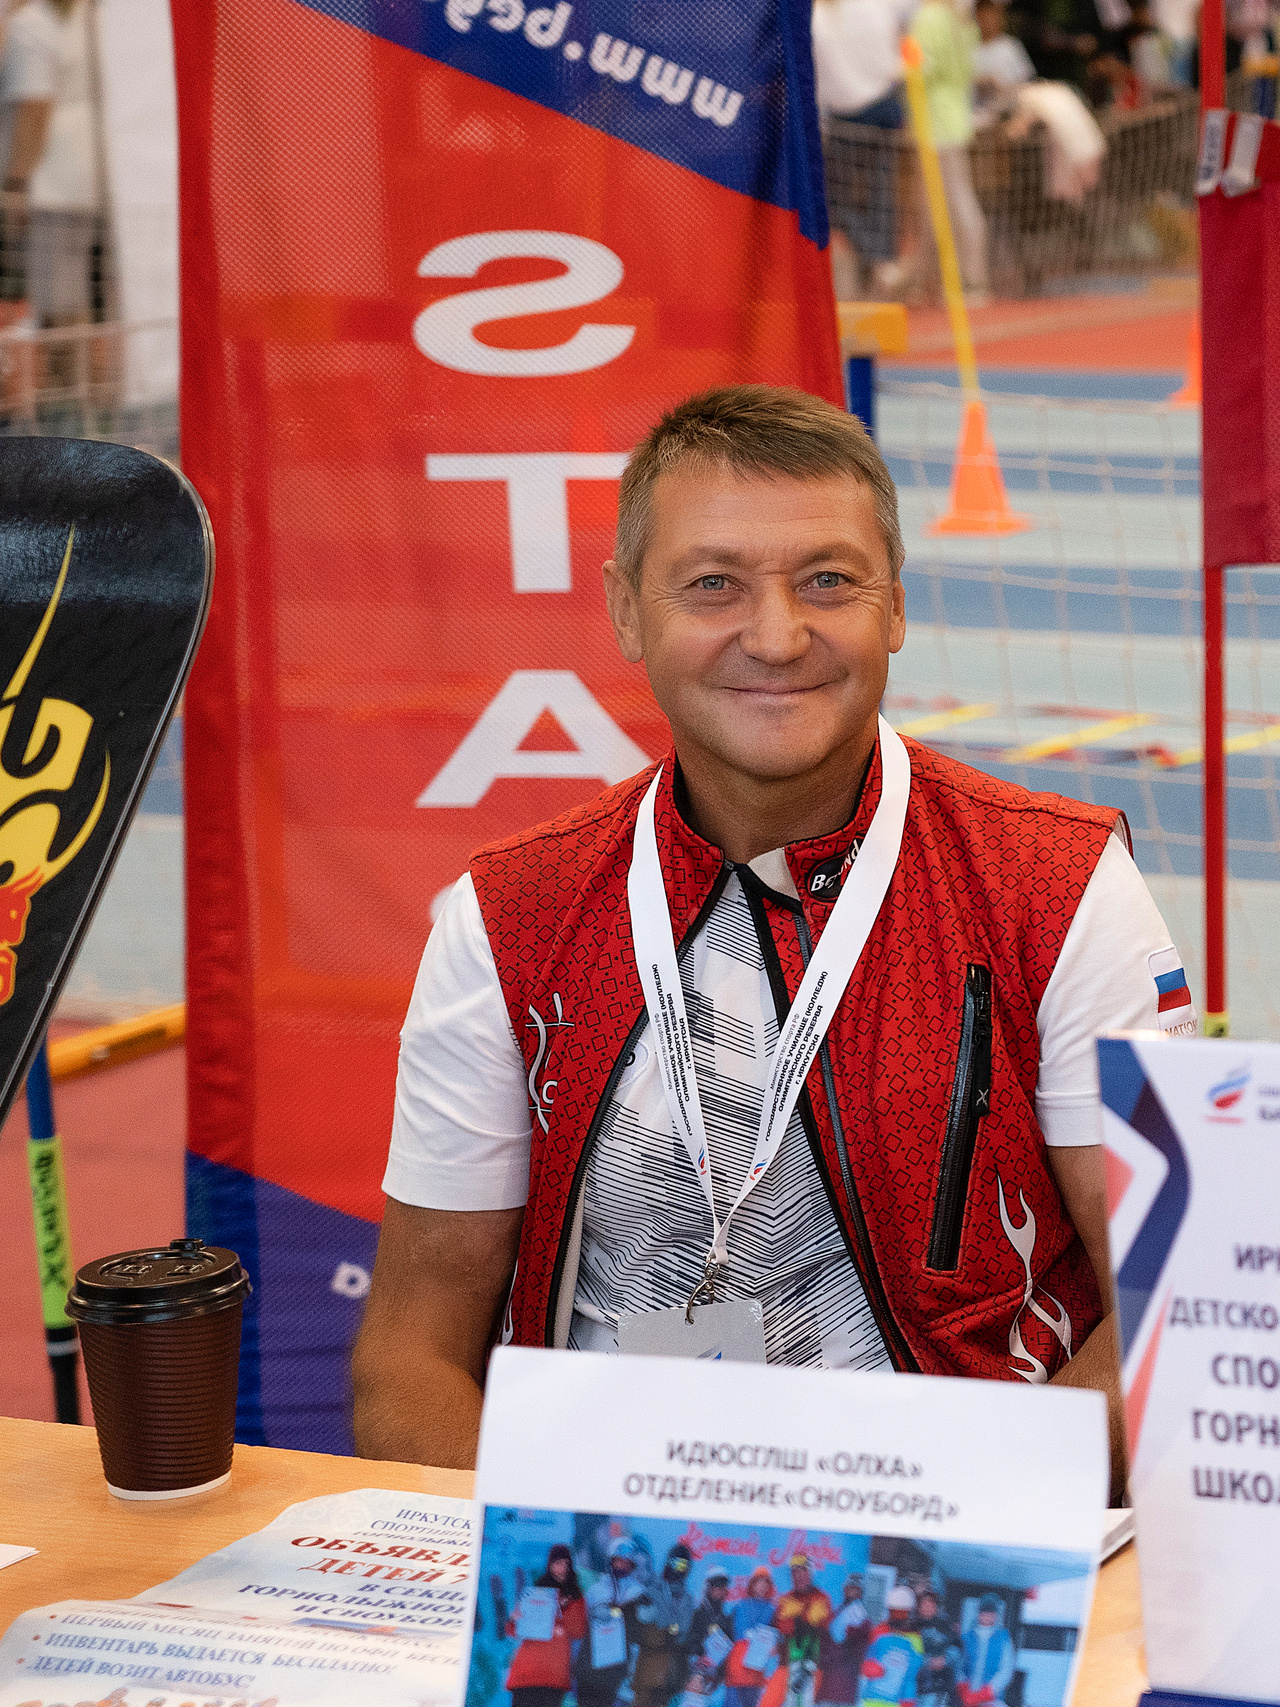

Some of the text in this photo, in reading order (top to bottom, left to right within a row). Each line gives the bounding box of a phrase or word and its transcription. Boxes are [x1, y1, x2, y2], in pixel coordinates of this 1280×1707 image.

[651, 964, 693, 1136] ГОСУДАРСТВЕННОЕ УЧИЛИЩЕ (КОЛЛЕДЖ)
[666, 993, 692, 1102] ОЛИМПИЙСКОГО РЕЗЕРВА
[678, 1018, 692, 1062] ИРКУТСКА
[764, 970, 829, 1142] ГОСУДАРСТВЕННОЕ УЧИЛИЩЕ (КОЛЛЕДЖ)
[777, 1005, 824, 1112] ОЛИМПИЙСКОГО РЕЗЕРВА
[797, 1034, 820, 1078] ИРКУТСКА
[666, 1438, 923, 1480] ИДЮСГЛШ «ОЛХА»
[296, 1557, 448, 1584] ДЕТЕЙ
[358, 1583, 381, 1593] В
[293, 1604, 320, 1614] И
[45, 1632, 399, 1674] ИНВЕНТАРЬ ВЫДАЕТСЯ БЕСПЛАТНО!
[60, 1613, 148, 1632] ПЕРВЫЙ
[152, 1623, 221, 1641] МЕСЯЦ
[318, 1641, 346, 1653] ПО
[26, 1655, 256, 1688] ДЕТЕЙ ВОЗИТ АВТОБУС!
